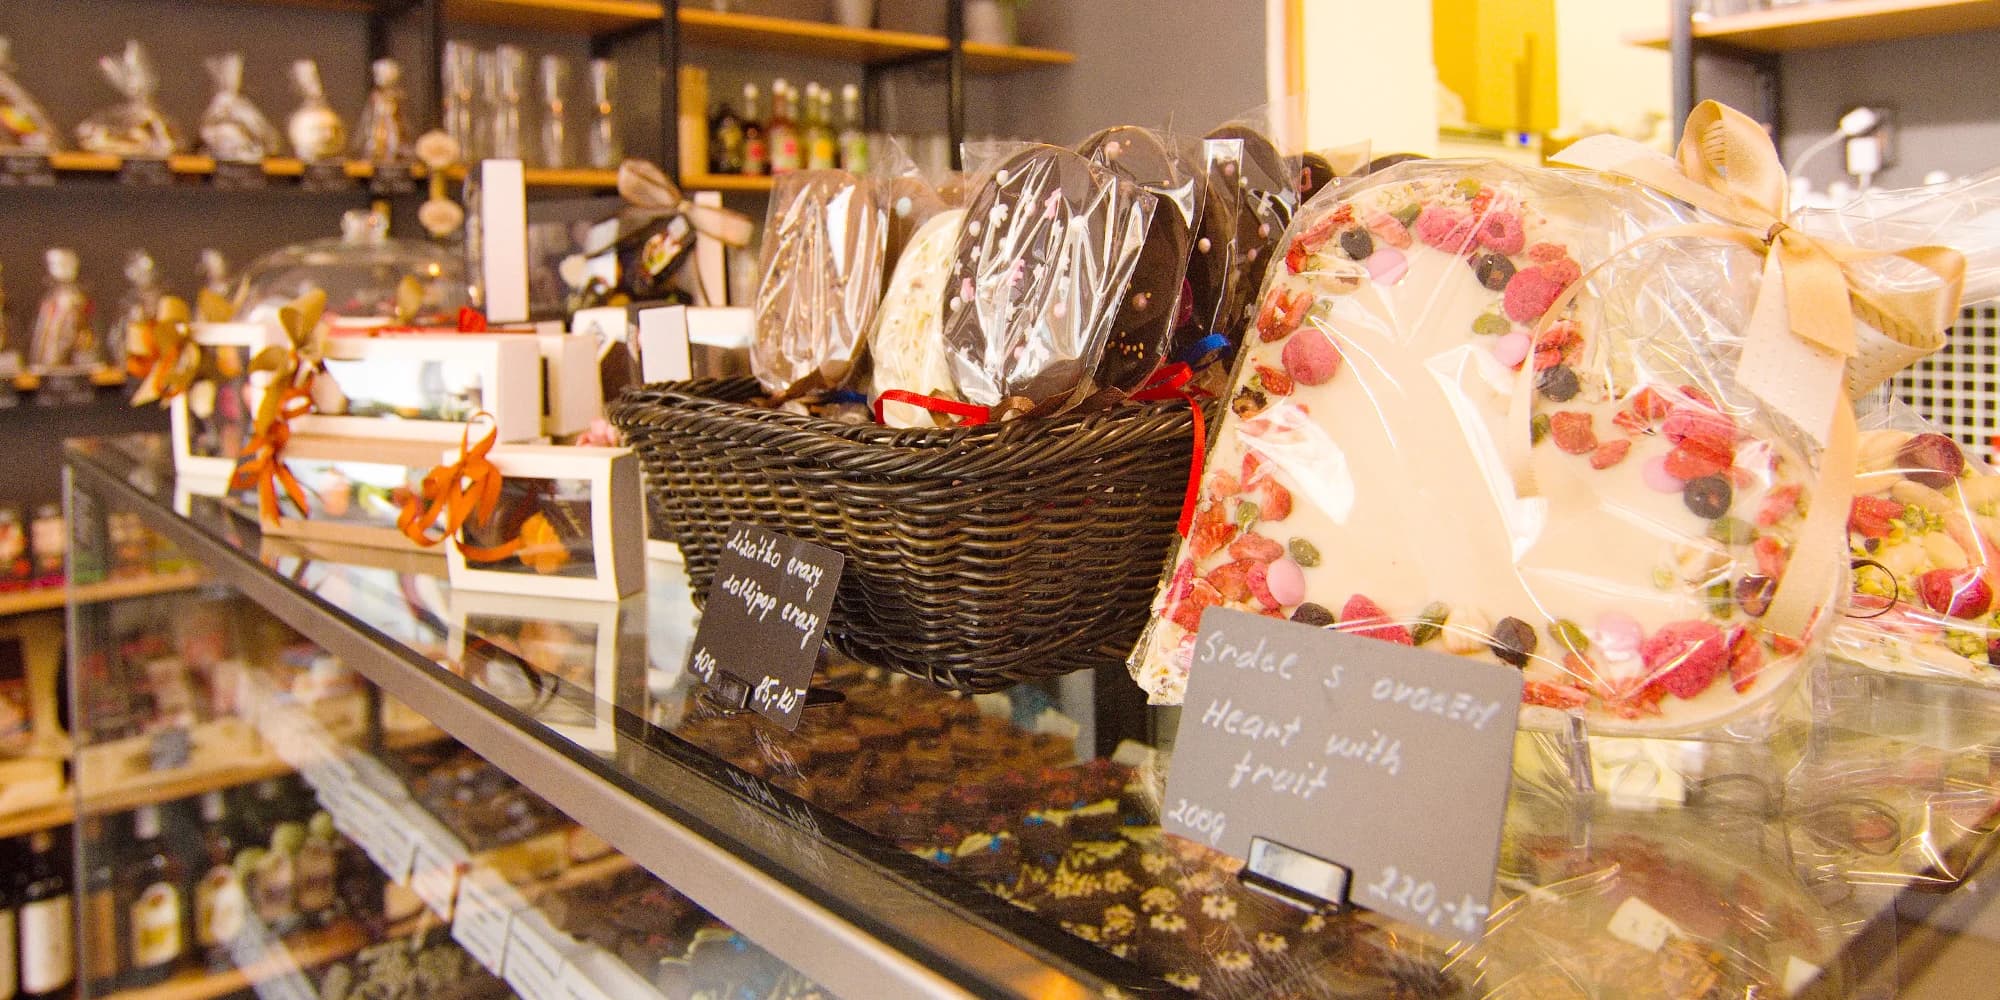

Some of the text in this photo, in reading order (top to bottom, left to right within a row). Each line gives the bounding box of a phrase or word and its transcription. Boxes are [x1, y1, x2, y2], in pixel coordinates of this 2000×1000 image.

[781, 602, 820, 650] crazy
[1202, 698, 1402, 776] Heart with
[1228, 750, 1328, 799] fruit
[1167, 798, 1226, 845] 200g
